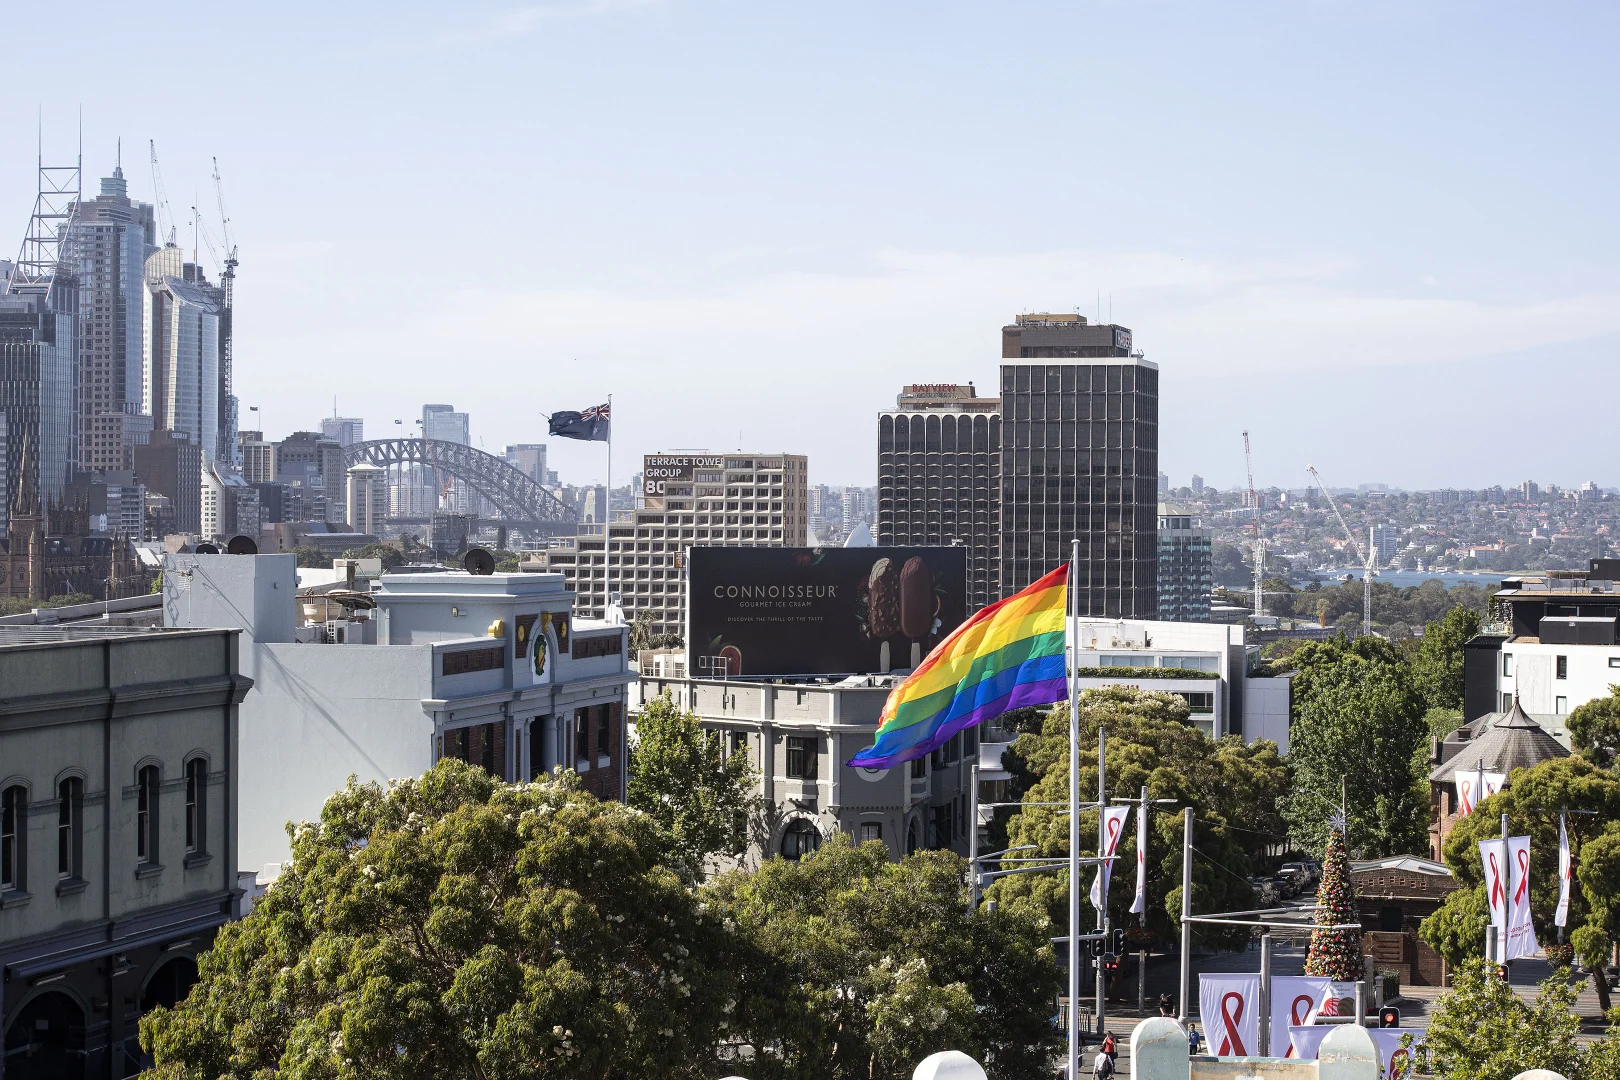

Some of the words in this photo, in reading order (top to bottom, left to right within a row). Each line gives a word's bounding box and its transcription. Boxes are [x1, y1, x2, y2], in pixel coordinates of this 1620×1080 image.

[912, 384, 957, 393] BAYVIEW
[645, 457, 689, 466] TERRACE
[645, 468, 682, 477] GROUP
[714, 585, 837, 598] CONNOISSEUR
